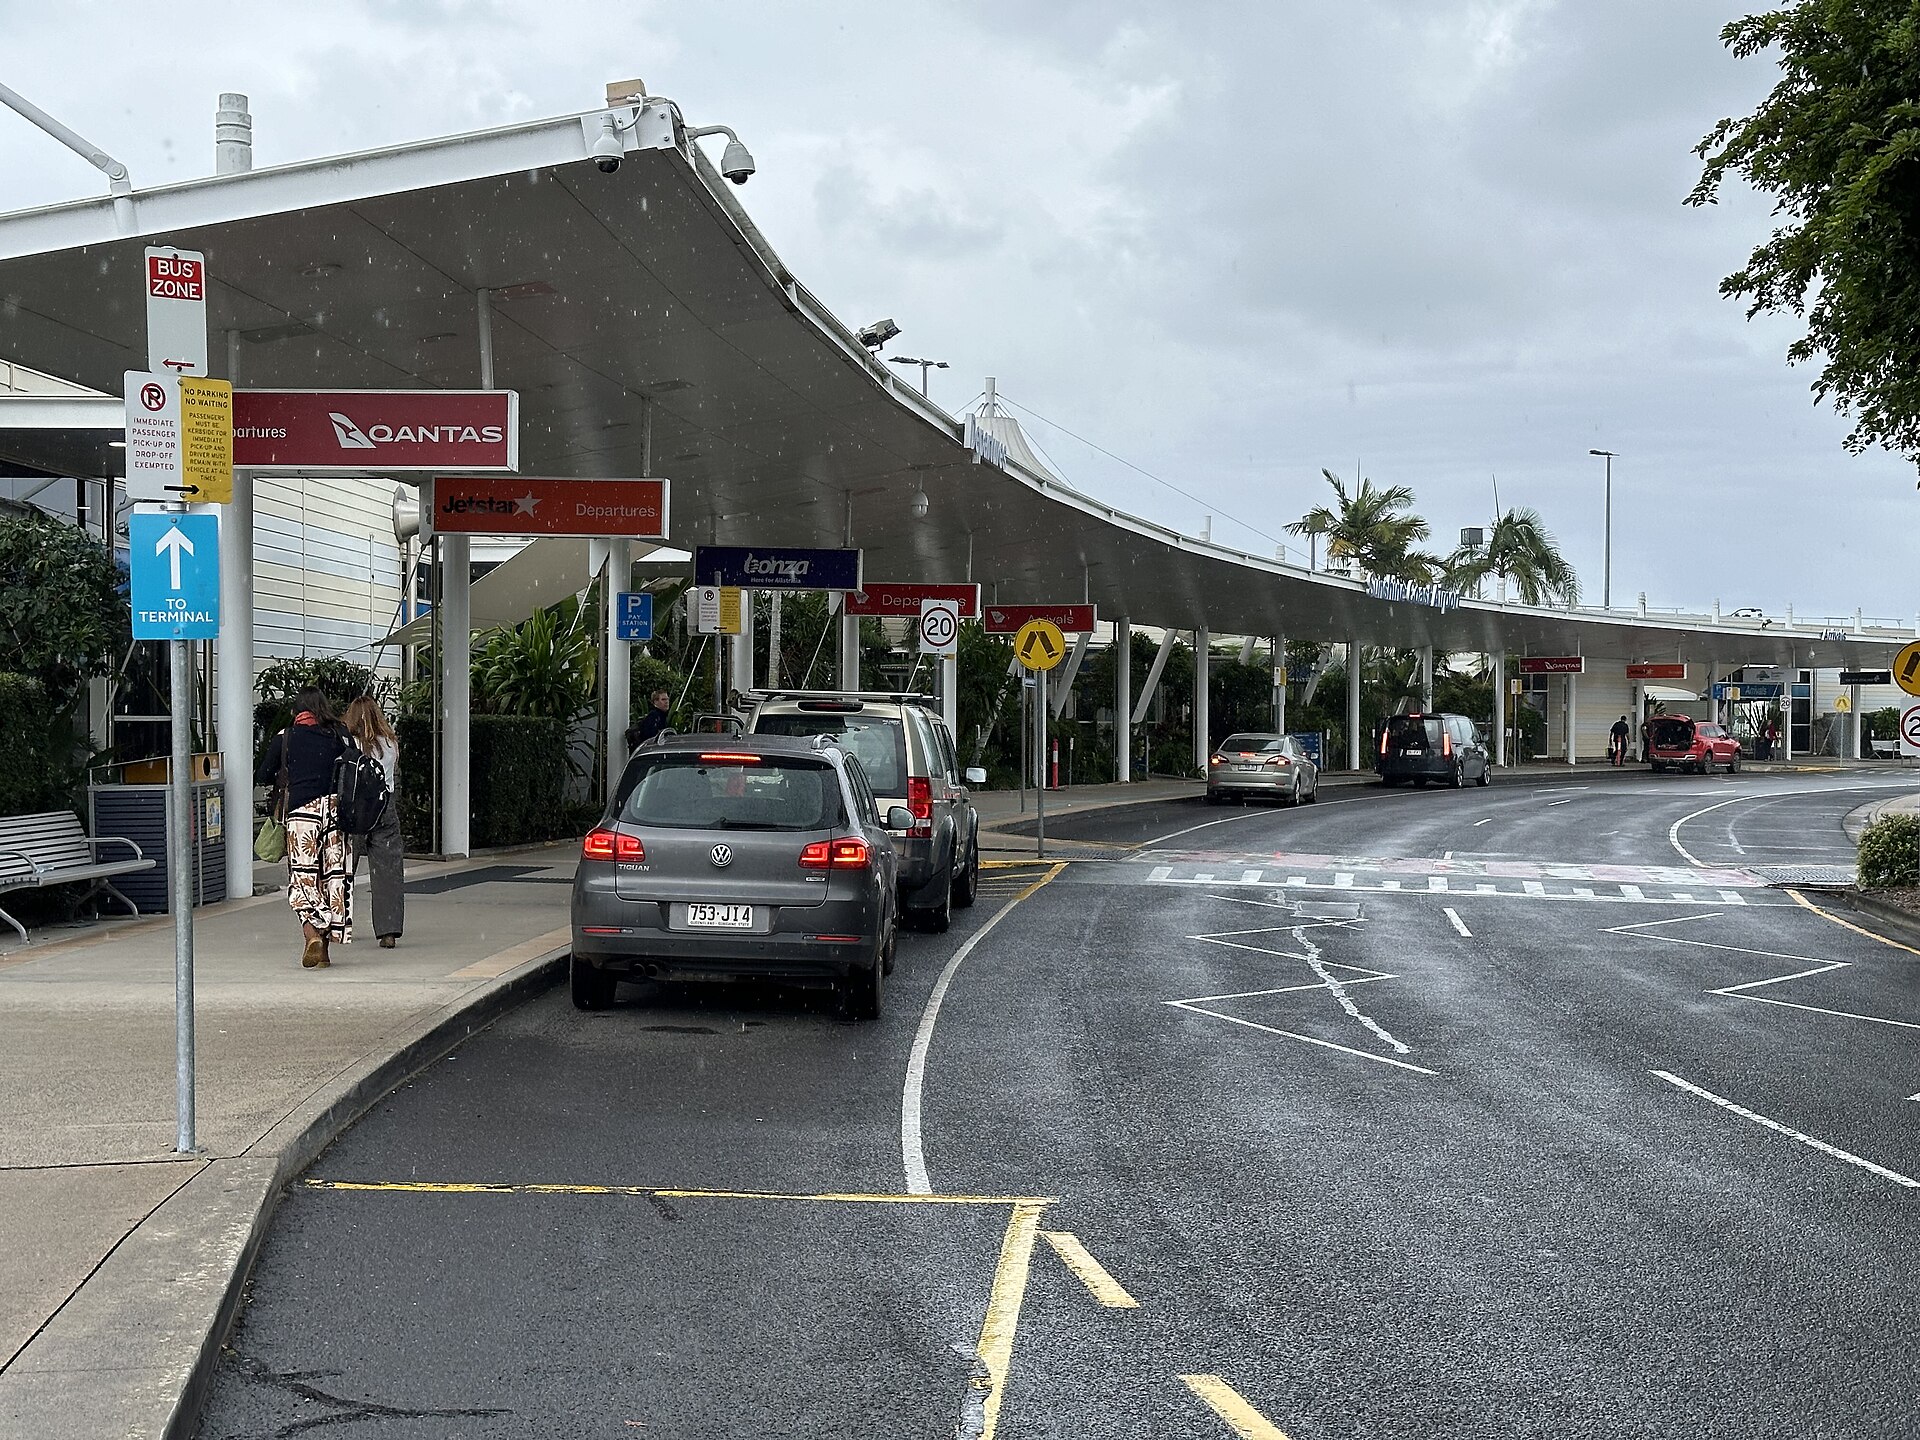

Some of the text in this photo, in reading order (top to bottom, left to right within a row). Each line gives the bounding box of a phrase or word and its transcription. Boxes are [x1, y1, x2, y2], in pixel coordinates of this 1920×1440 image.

[157, 260, 194, 278] BUS
[152, 279, 200, 298] ZONE
[184, 388, 229, 399] NO PARKING
[185, 398, 228, 409] NO WAITING
[133, 417, 174, 427] IMMEDIATE
[189, 412, 225, 421] PASSENGERS
[132, 428, 176, 438] PASSENGER
[187, 428, 215, 436] KERBSIDE
[368, 424, 504, 443] QANTAS
[132, 439, 176, 450] PICK-UP OR
[135, 450, 173, 460] DROP-OFF
[189, 451, 211, 459] DRIVER
[134, 461, 174, 471] EXEMPTED
[186, 466, 210, 474] VEHICLE
[442, 496, 656, 519] Jetstar Departures
[743, 552, 810, 575] bonza
[165, 598, 187, 610] TO
[627, 595, 642, 613] P
[882, 594, 966, 608] Depas
[138, 611, 214, 622] TERMINAL
[1028, 614, 1074, 625] Aivals
[926, 617, 952, 636] 20
[618, 863, 650, 872] TIGUAN
